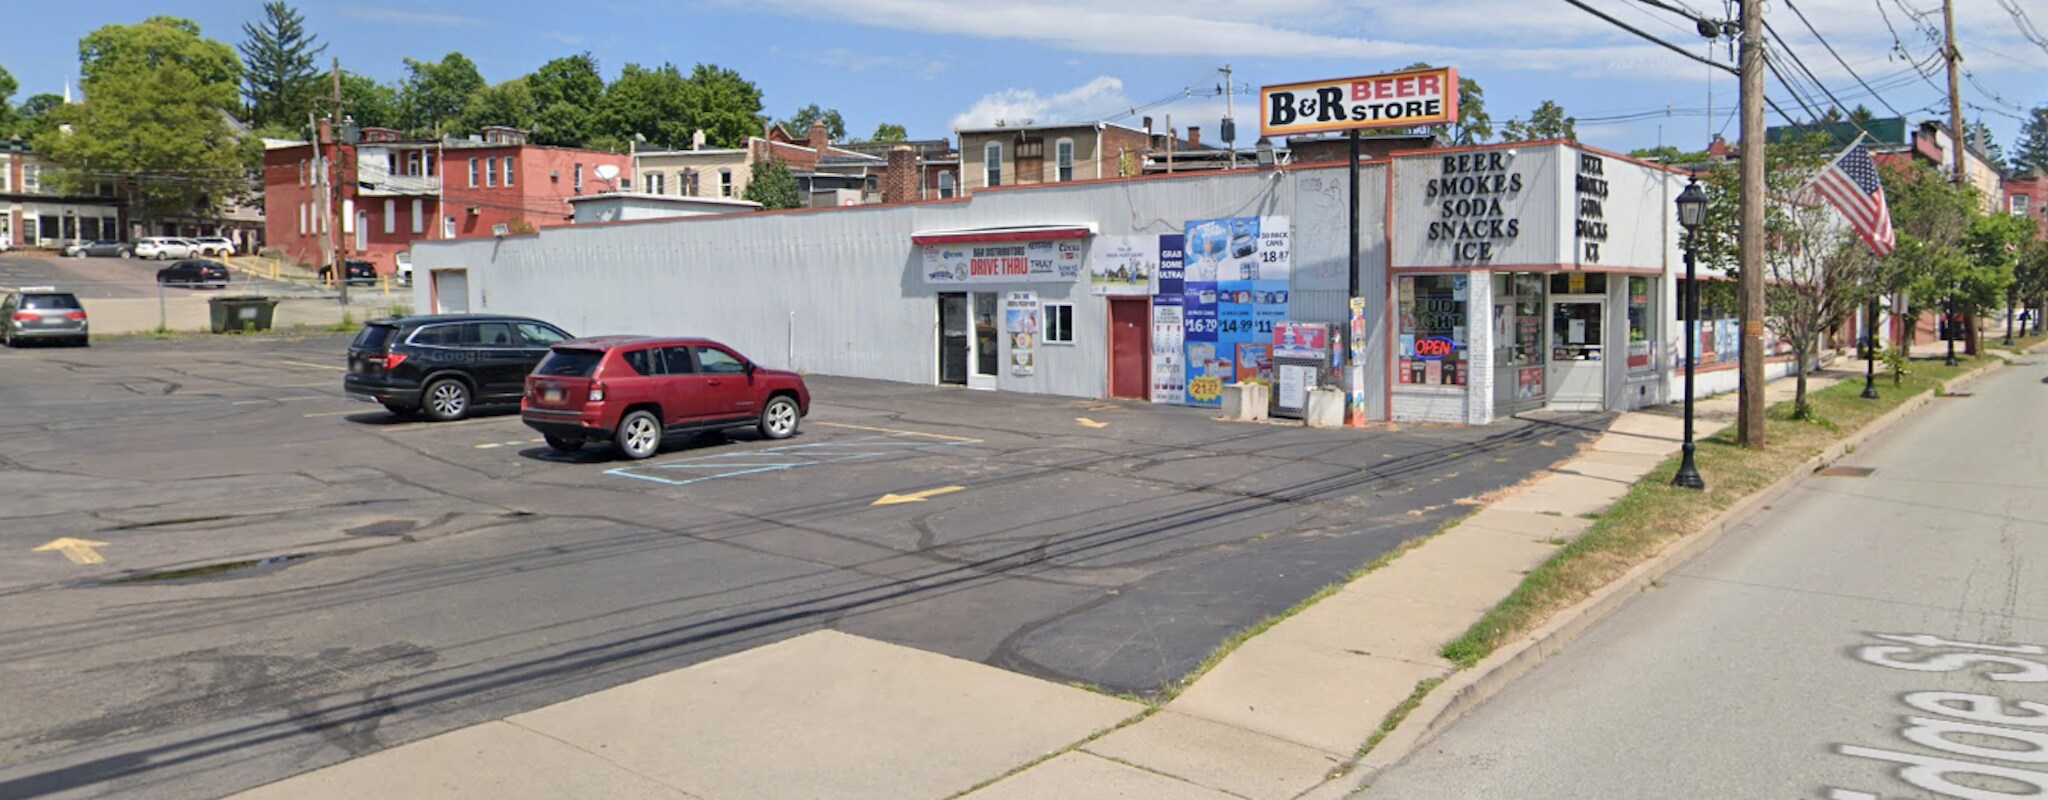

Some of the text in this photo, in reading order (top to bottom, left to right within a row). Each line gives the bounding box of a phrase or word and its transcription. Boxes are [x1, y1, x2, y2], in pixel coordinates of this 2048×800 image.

[1269, 75, 1440, 126] B&R BEER
[1351, 99, 1440, 121] STORE
[1443, 152, 1505, 174] BEER
[1427, 173, 1522, 198] SMOKES
[1442, 197, 1503, 218] SODA
[1428, 219, 1519, 240] SNACKS
[1161, 250, 1182, 259] GRAB
[1454, 242, 1493, 261] ICE
[970, 258, 999, 276] DRIVE
[1001, 256, 1028, 275] THRU
[1030, 259, 1054, 268] TRULY
[1161, 260, 1183, 269] SOME
[1185, 319, 1218, 333] $16.70
[1219, 319, 1253, 333] $14.99
[1415, 339, 1451, 355] OPEN
